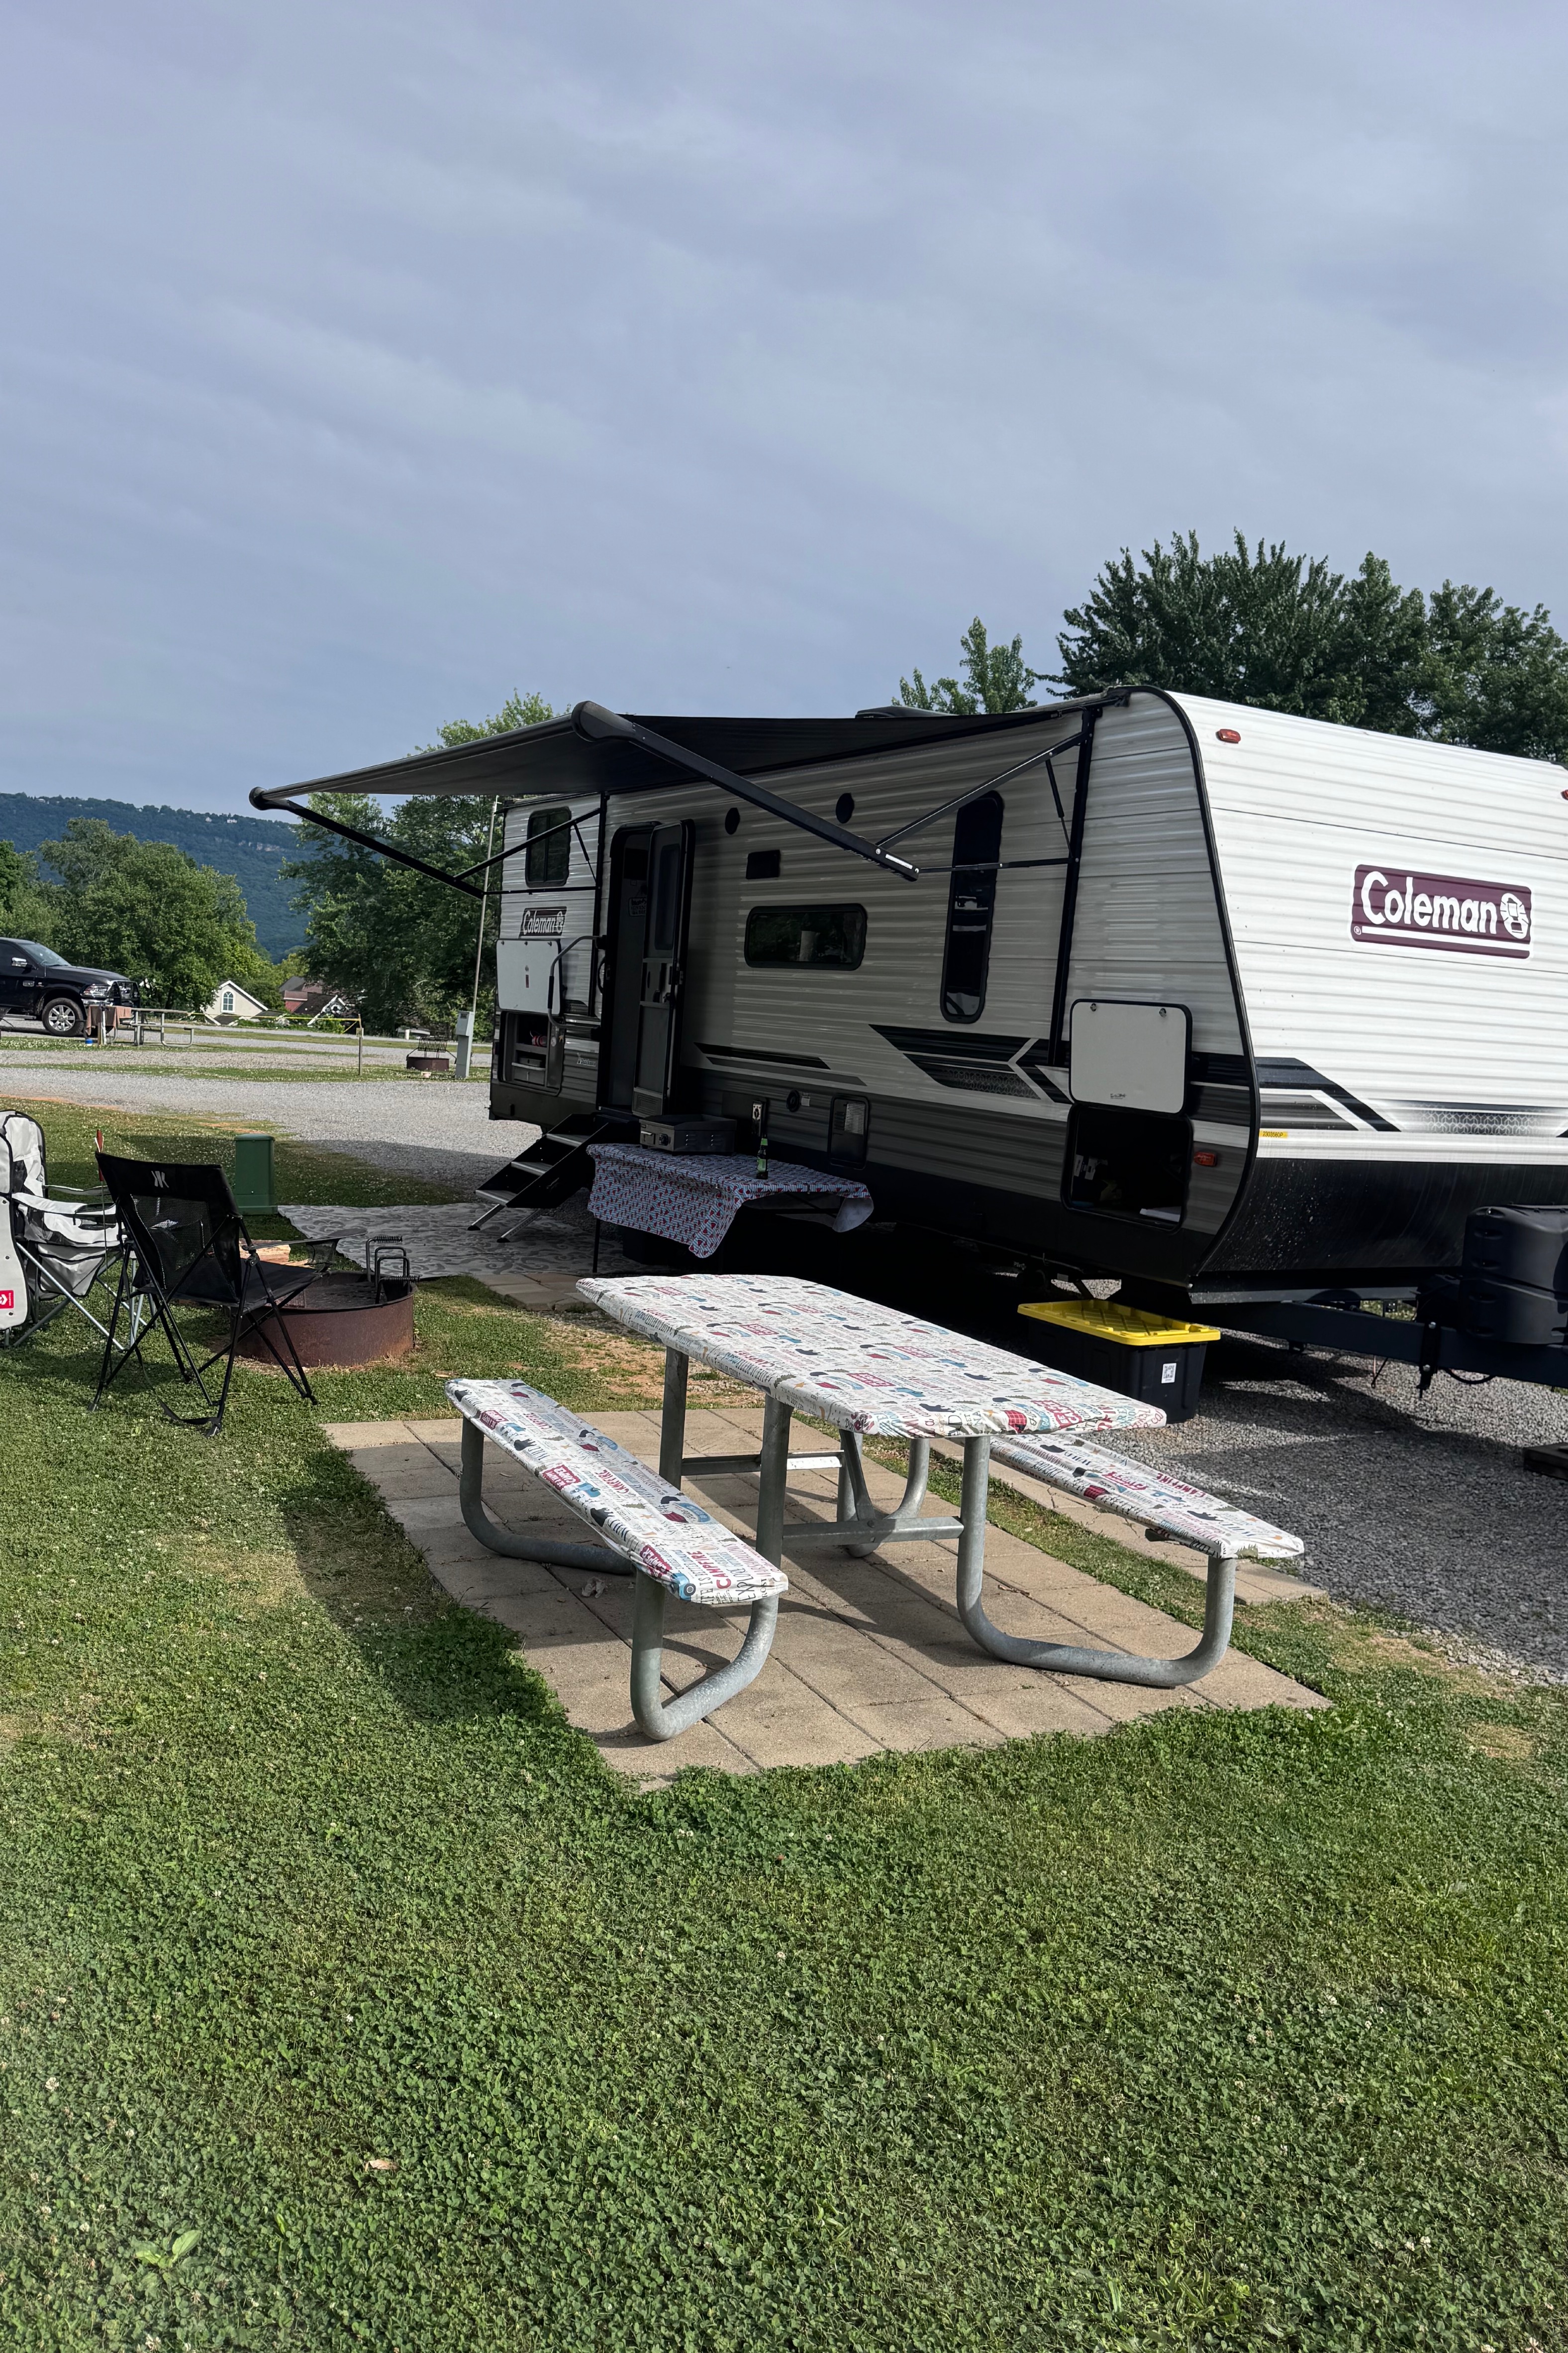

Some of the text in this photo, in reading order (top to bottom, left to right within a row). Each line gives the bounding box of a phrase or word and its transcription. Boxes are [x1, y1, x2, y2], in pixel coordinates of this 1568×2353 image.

[1361, 871, 1497, 934] Coleman
[523, 911, 556, 935] Coleman
[734, 1350, 775, 1366] CAMPFIRE
[523, 1412, 553, 1430] CAMPFIRE
[552, 1466, 577, 1483] CAMPER
[595, 1469, 629, 1494] CAMPFIRE
[1156, 1473, 1206, 1498] CAMPFIRE
[688, 1551, 732, 1589] CAMPFIRE
[725, 1543, 770, 1577] MARSHMALLOWS
[699, 1577, 713, 1587] IS
[727, 1564, 757, 1602] EXPLORE
